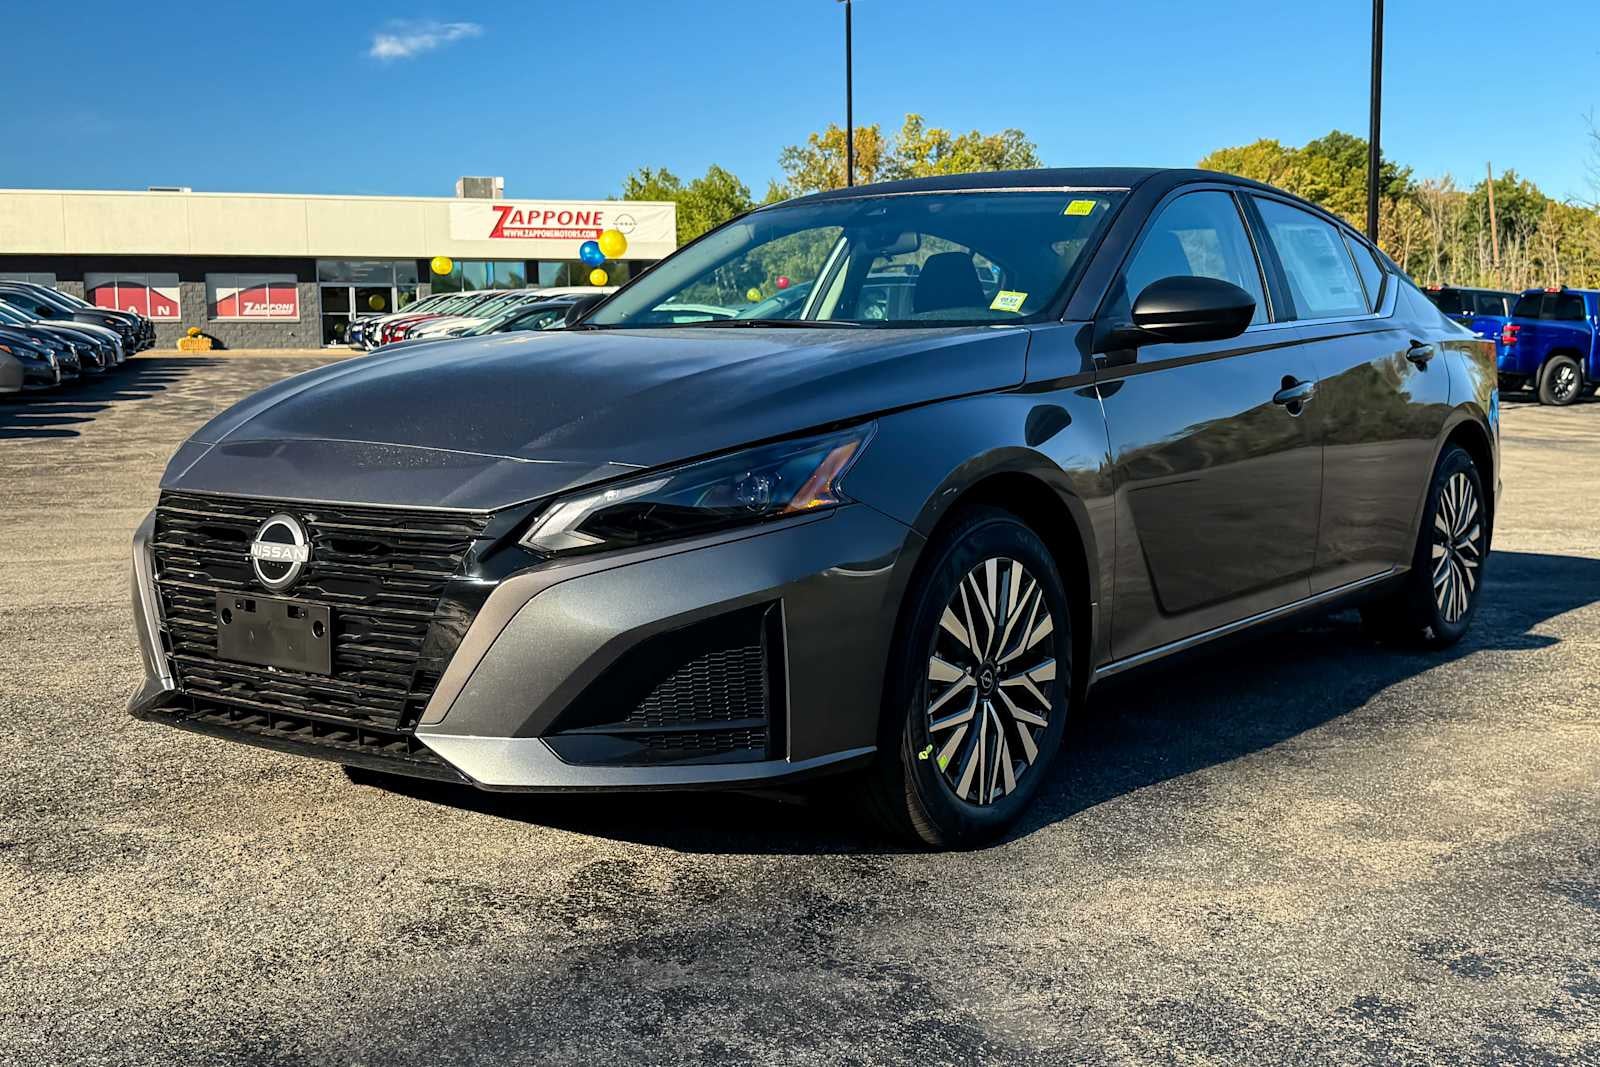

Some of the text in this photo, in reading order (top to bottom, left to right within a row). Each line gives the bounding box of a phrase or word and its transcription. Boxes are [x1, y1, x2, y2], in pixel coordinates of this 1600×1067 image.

[489, 206, 604, 238] ZAPPONE
[503, 229, 598, 239] WWW.ZAPPONEMOTORS.COM
[250, 543, 309, 562] NISSAN
